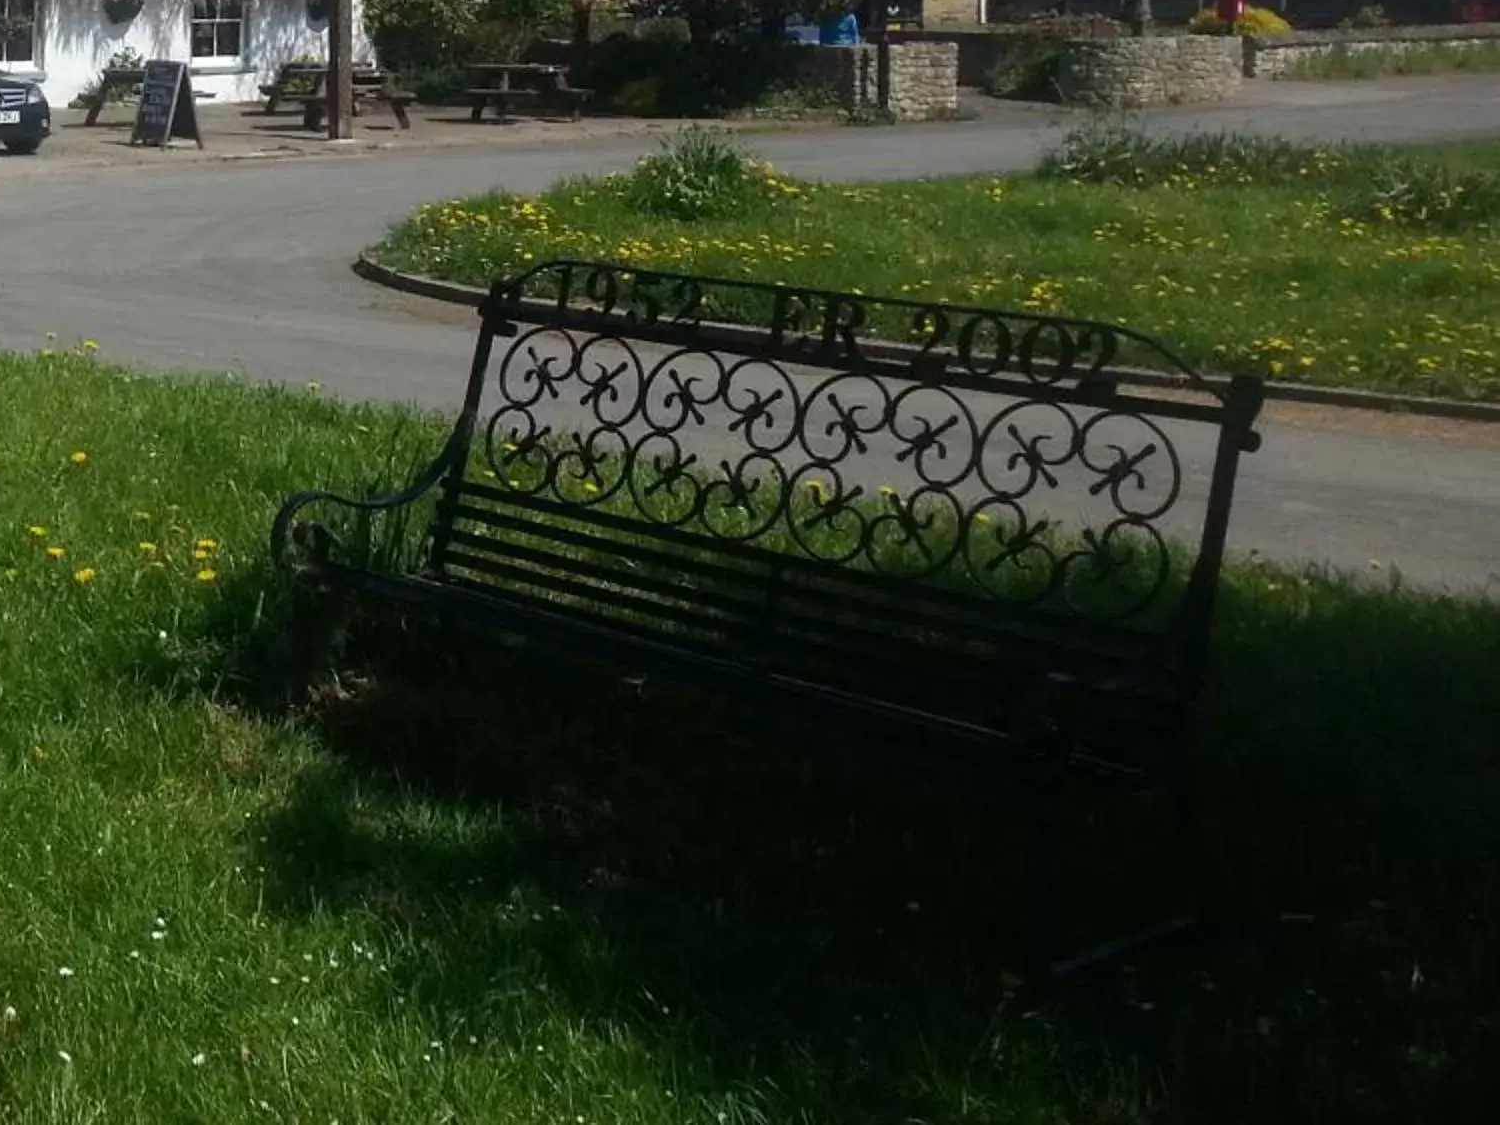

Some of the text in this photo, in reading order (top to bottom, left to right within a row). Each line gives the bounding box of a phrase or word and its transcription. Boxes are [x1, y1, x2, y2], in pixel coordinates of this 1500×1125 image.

[554, 264, 1120, 402] 1952 ER 2002
